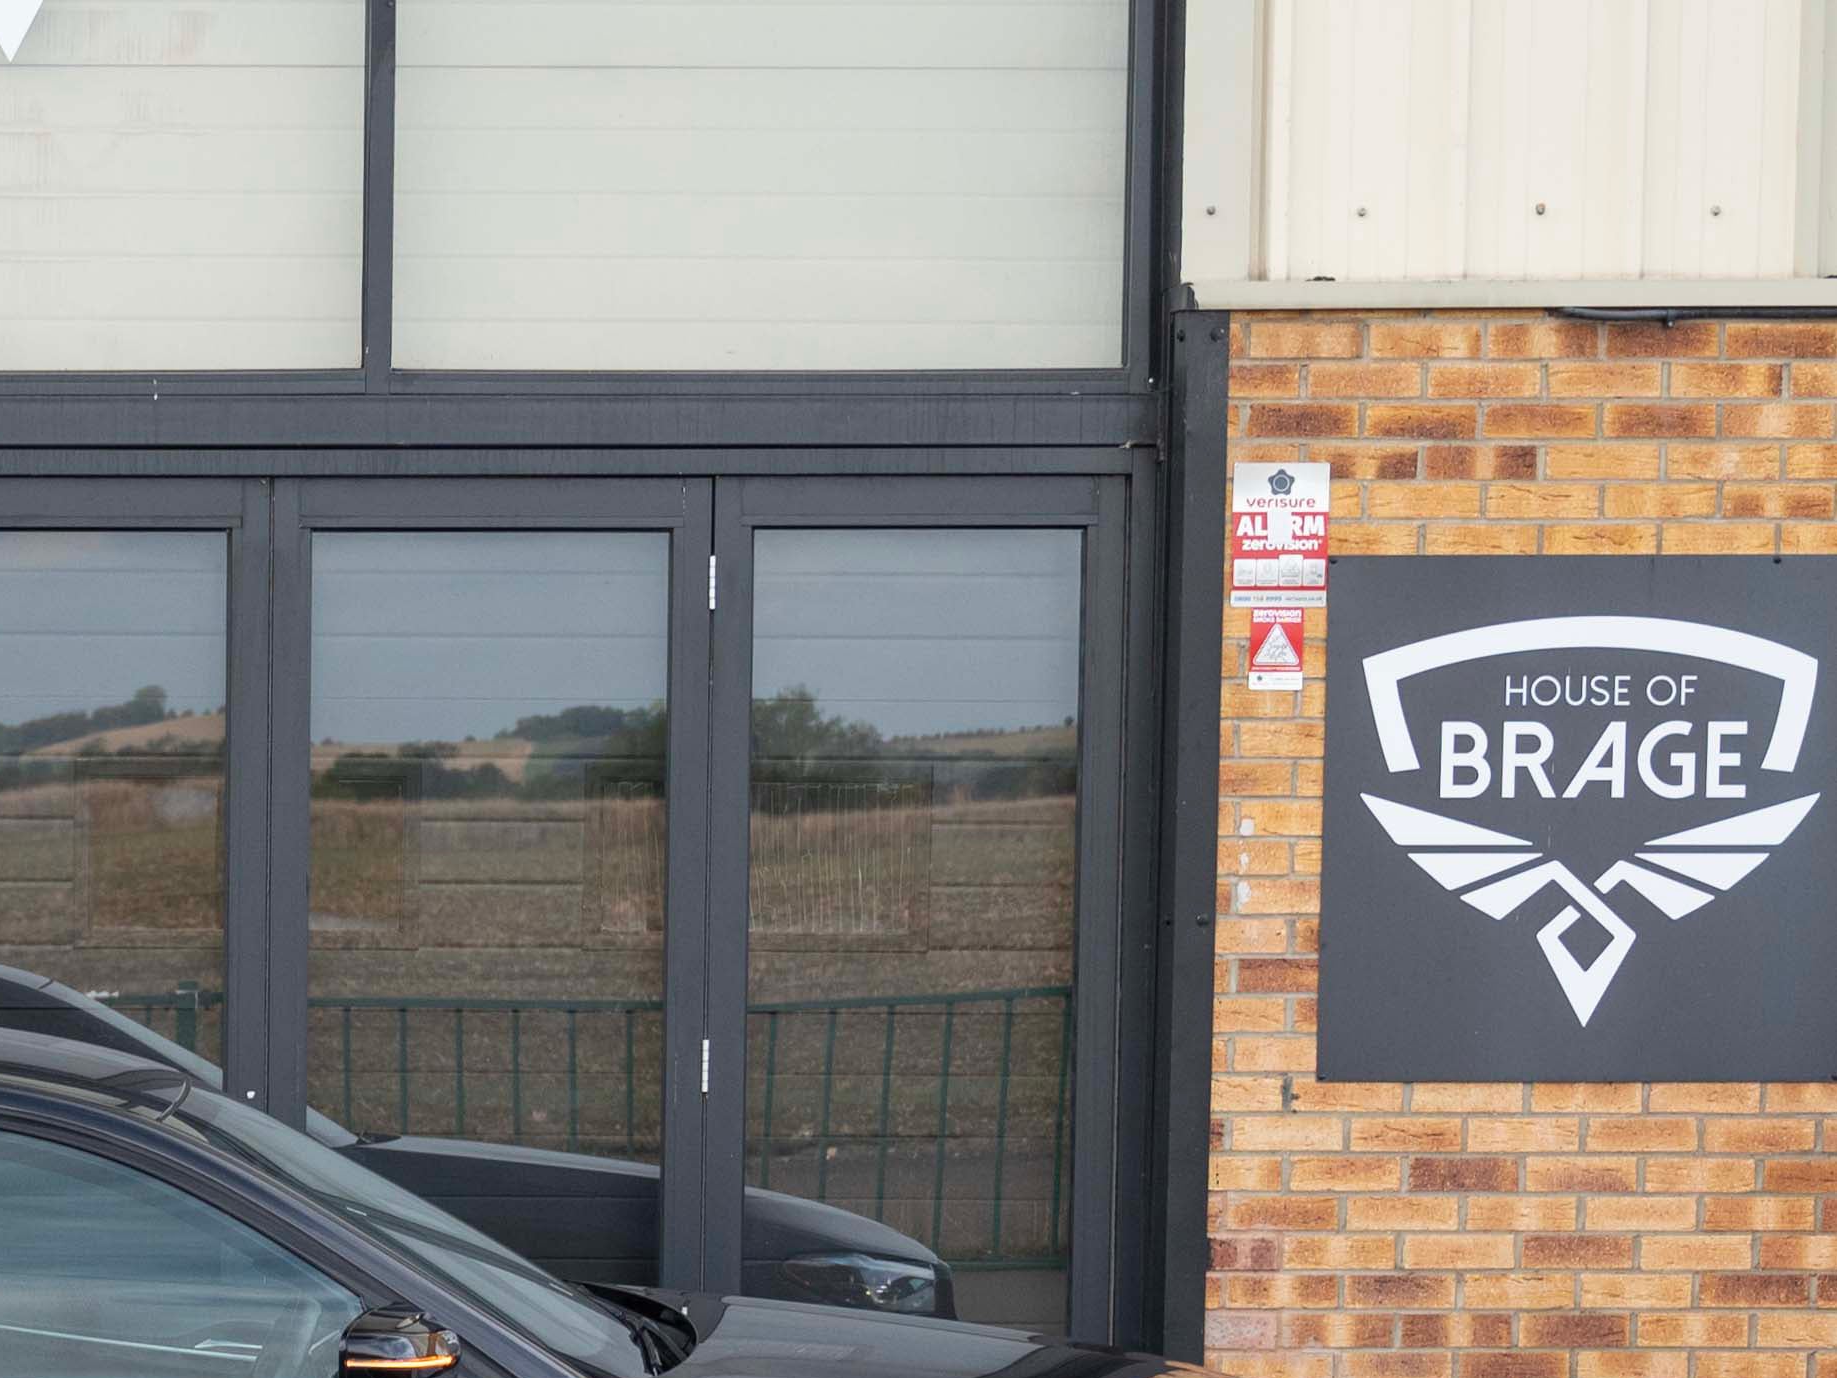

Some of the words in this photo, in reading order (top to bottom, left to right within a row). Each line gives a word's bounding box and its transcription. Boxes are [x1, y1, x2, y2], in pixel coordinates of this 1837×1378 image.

[1246, 498, 1316, 508] verisure
[1236, 515, 1325, 537] ALRM
[1505, 675, 1631, 707] HOUSE
[1646, 675, 1699, 707] OF
[1439, 720, 1749, 799] BRAGE
